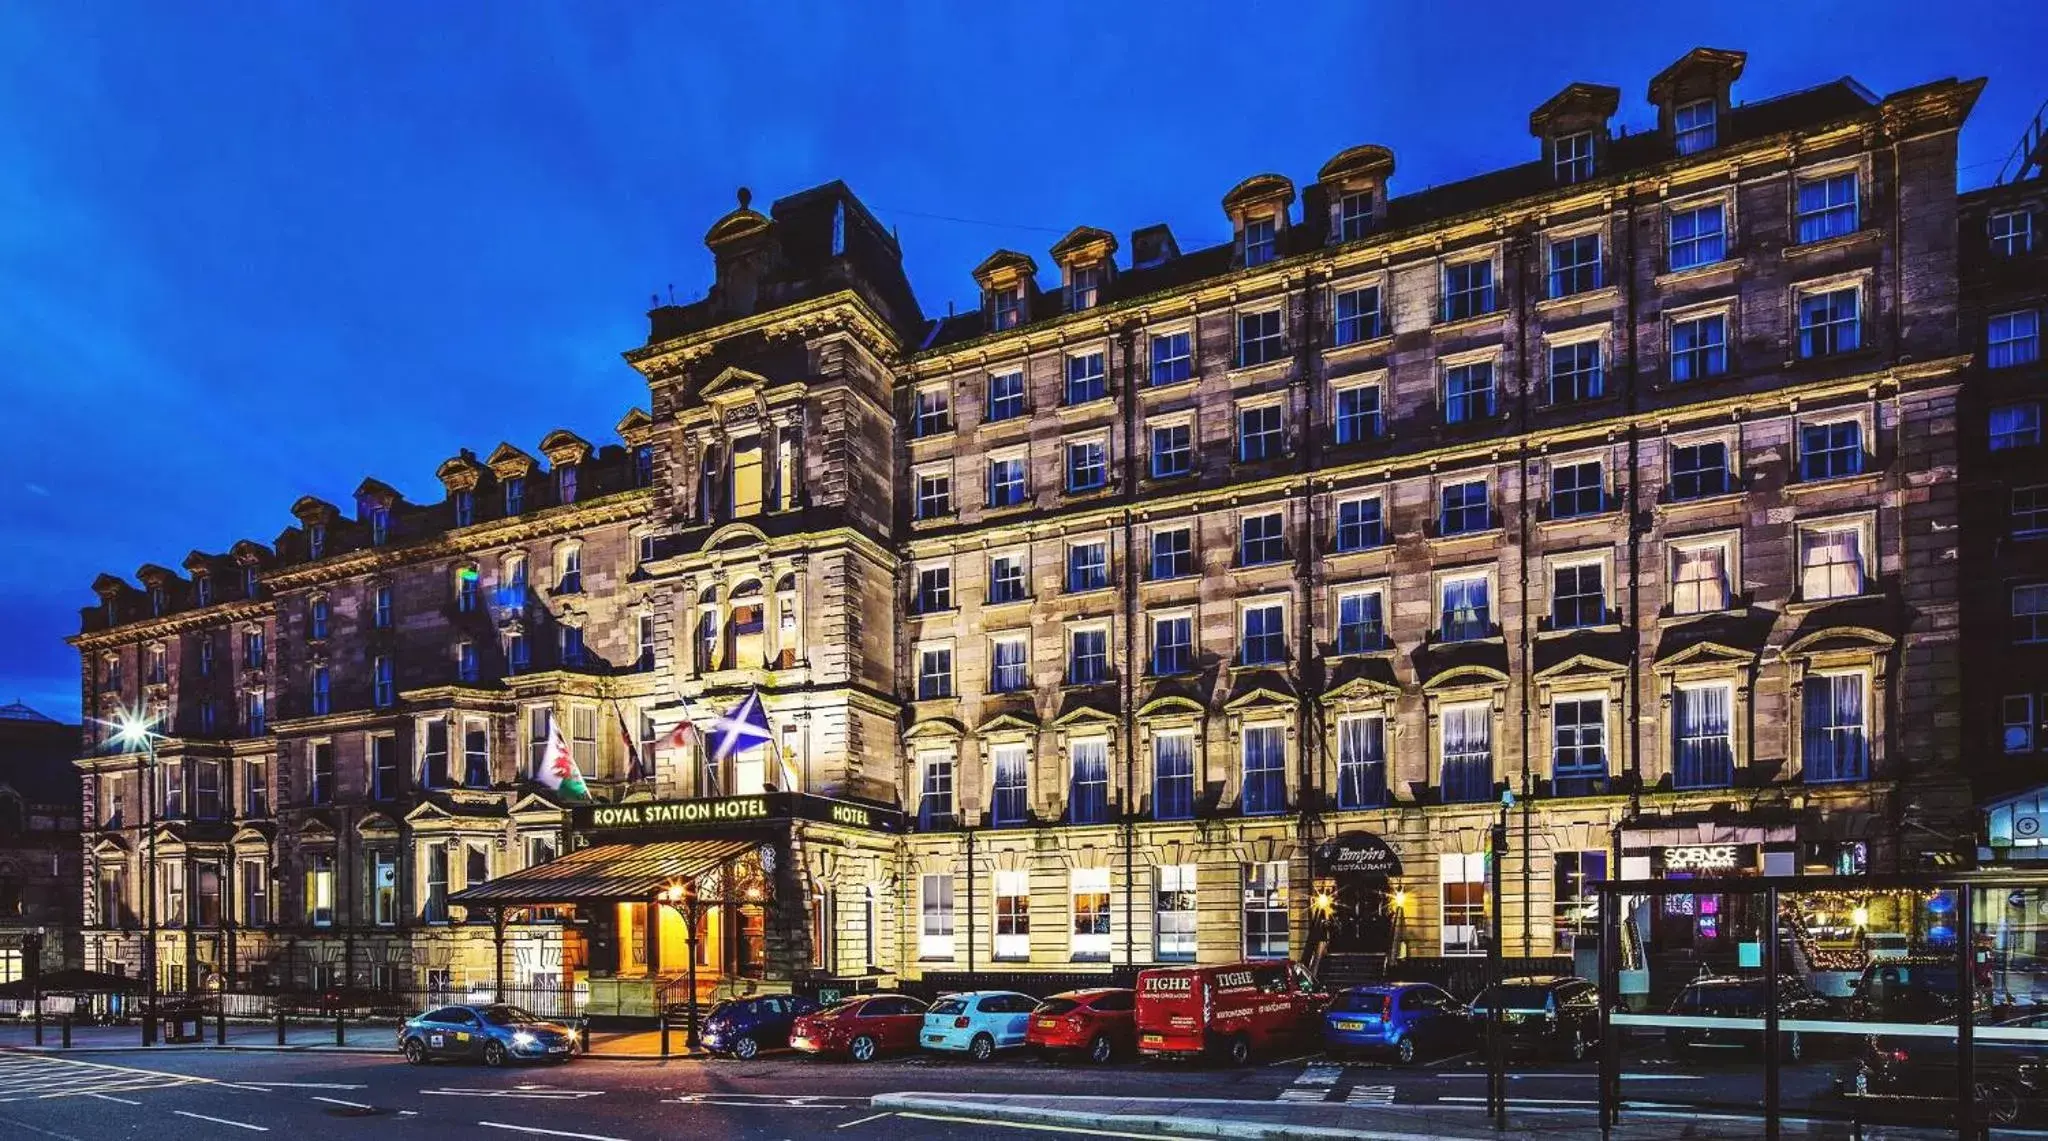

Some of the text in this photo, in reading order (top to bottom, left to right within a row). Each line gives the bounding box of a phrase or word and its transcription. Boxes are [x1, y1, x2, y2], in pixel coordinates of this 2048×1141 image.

[594, 800, 767, 825] ROYAL STATION HOTEL
[833, 806, 869, 825] HOTEL
[1338, 847, 1386, 863] Empire
[1665, 847, 1737, 861] SCIENCE
[1331, 863, 1394, 871] RESTAURANT
[1144, 978, 1192, 990] TIGHE
[1216, 971, 1254, 987] TIGHE
